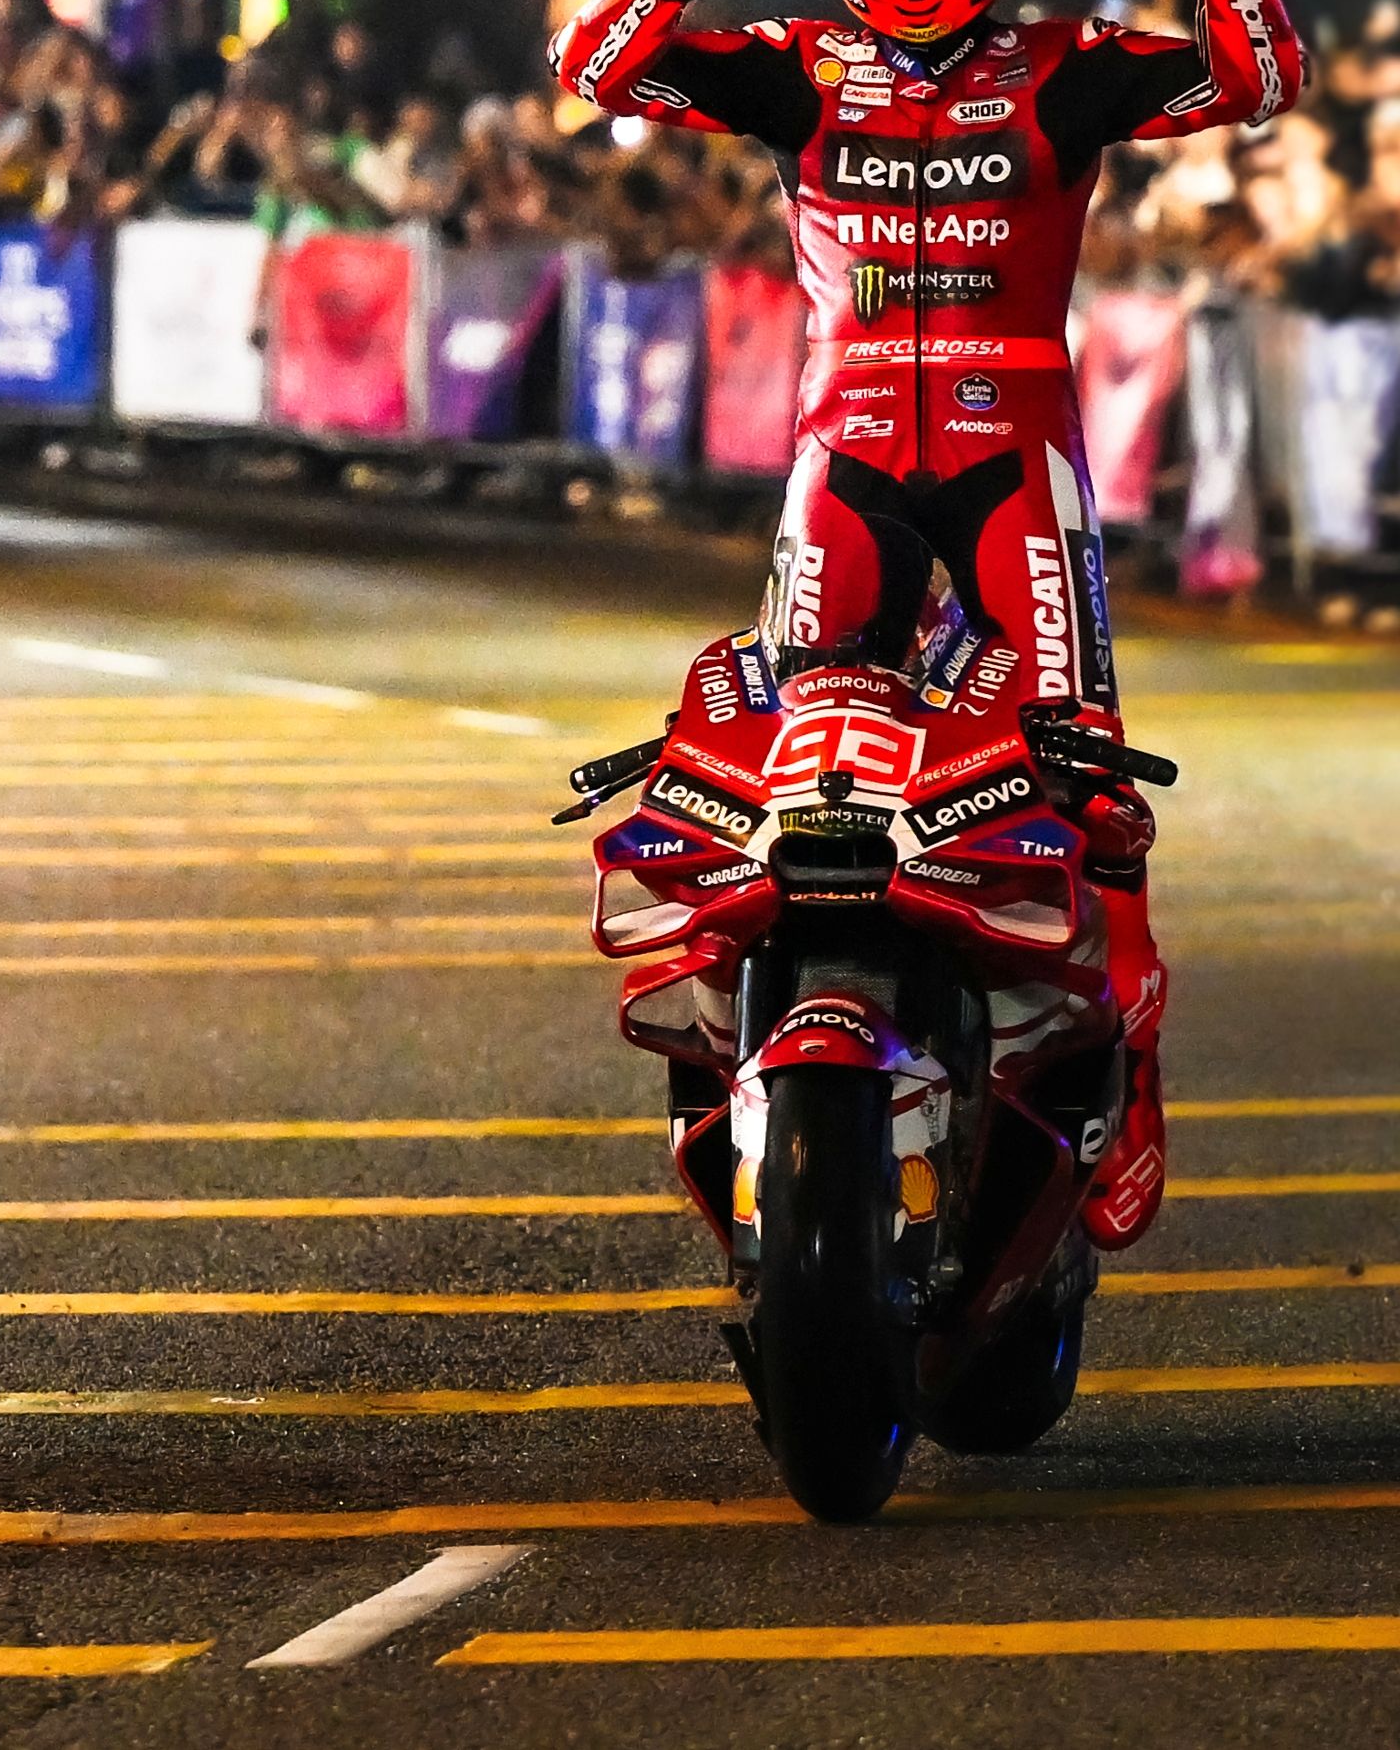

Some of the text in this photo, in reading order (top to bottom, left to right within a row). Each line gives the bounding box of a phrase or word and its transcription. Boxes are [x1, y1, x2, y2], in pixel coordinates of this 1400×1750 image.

[891, 49, 916, 73] TIM
[929, 37, 976, 76] Lenovo
[837, 108, 865, 122] SAP
[958, 102, 1006, 120] SHOEI
[836, 146, 1012, 191] Lenovo
[871, 214, 1010, 247] NetApp
[888, 271, 996, 290] MONSTER
[843, 338, 1005, 358] FRECCIAROSSA
[838, 386, 897, 401] VERTICAL
[943, 418, 1014, 435] MotoGP
[1025, 535, 1071, 699] DUCATI
[1082, 547, 1113, 694] Lenovo
[968, 648, 1021, 701] riello
[696, 663, 739, 724] riello
[672, 741, 767, 789] FRECCIAROSSA
[762, 710, 925, 794] 93
[915, 738, 1020, 787] FRECCIAROSSA
[650, 772, 753, 836] Lenovo
[801, 808, 889, 828] MONSTER
[913, 777, 1031, 836] Lenovo
[638, 839, 685, 859] TIM
[1019, 840, 1065, 858] TIM
[696, 860, 763, 887] CARRERA
[903, 860, 982, 886] CARRERA
[769, 1013, 875, 1046] Lenovo
